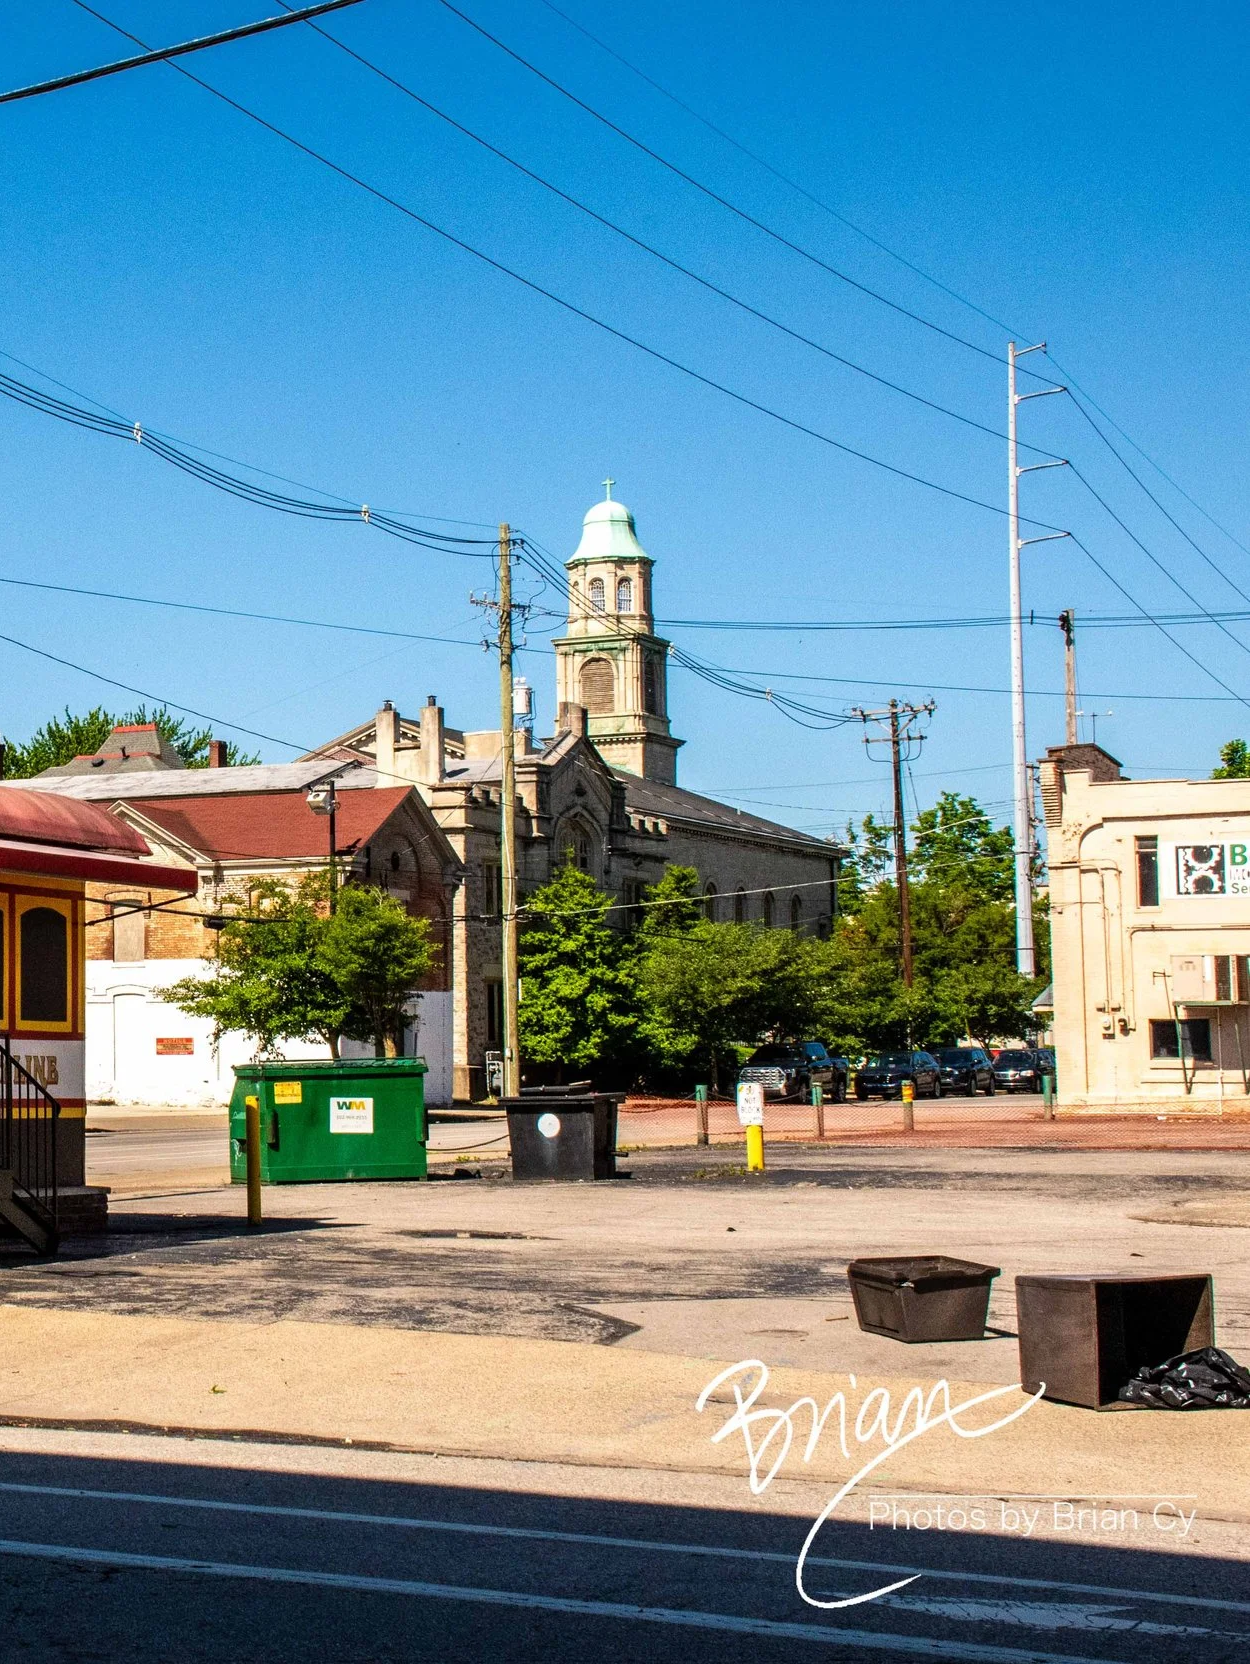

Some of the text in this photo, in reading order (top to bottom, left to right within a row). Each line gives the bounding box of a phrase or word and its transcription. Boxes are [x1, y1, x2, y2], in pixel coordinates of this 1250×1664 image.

[1231, 882, 1250, 894] Se
[13, 1055, 59, 1089] LINE
[336, 1101, 366, 1110] WM
